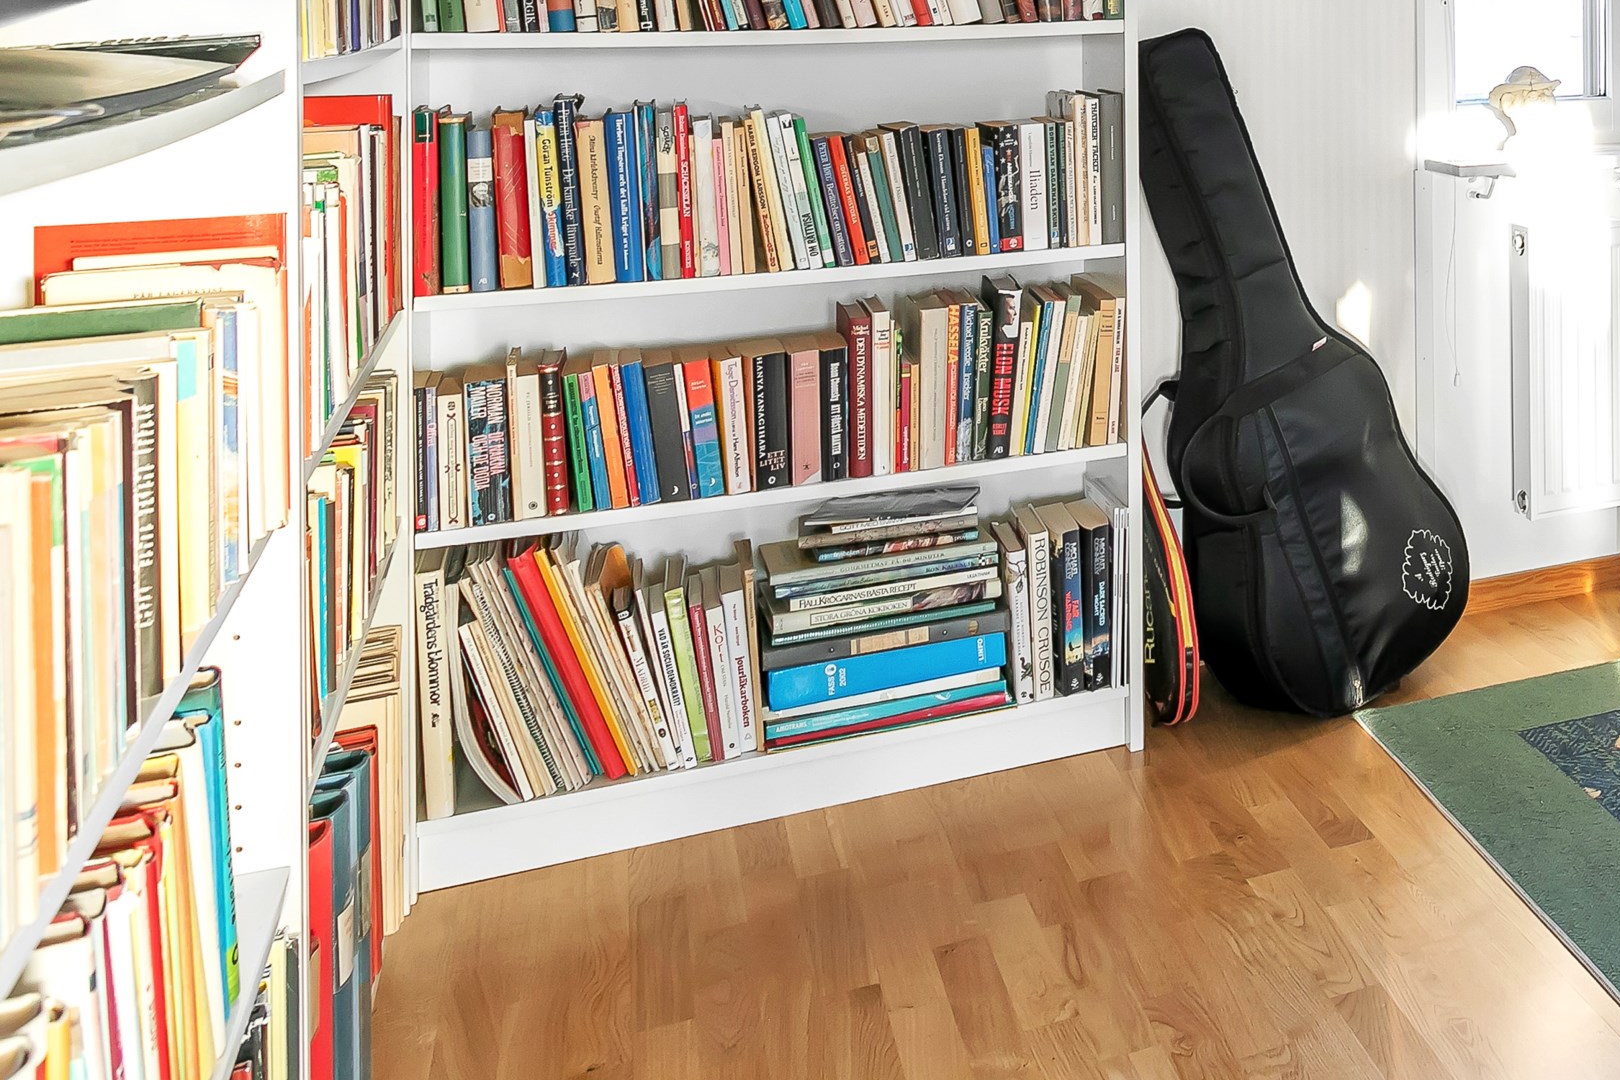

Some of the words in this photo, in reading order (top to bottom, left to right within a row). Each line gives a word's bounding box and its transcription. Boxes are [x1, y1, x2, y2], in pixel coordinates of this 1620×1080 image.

[558, 109, 571, 136] PETER
[615, 119, 623, 145] Herbert
[747, 124, 756, 147] MARIA
[541, 138, 553, 165] Göran
[817, 141, 828, 163] PETER
[935, 132, 944, 153] Kerstin
[616, 146, 625, 173] Tingsten
[751, 148, 760, 177] BERGOM
[937, 154, 945, 174] Ekman
[543, 166, 556, 208] Tunström
[562, 167, 574, 182] De
[619, 186, 627, 198] det
[756, 178, 766, 209] LARSSON
[825, 183, 839, 220] Berättelser
[839, 164, 850, 195] IDÉERNAS
[846, 195, 857, 224] HISTORIA
[939, 175, 948, 203] Händelser
[1029, 169, 1041, 210] Iliaden
[563, 186, 578, 221] kanske
[620, 199, 628, 216] kalla
[619, 216, 629, 236] kriget
[802, 212, 817, 243] RÄTTVISA
[833, 220, 841, 232] om
[564, 222, 582, 267] lämpade
[809, 243, 819, 257] OM
[836, 232, 846, 253] natten
[947, 305, 958, 363] HASSELA
[964, 309, 974, 339] Michael
[856, 337, 865, 355] DEN
[964, 339, 973, 366] Tweedie
[979, 318, 993, 373] Krukväxter
[993, 343, 1014, 375] ELON
[726, 361, 737, 379] Tage
[830, 362, 840, 377] Noam
[857, 355, 866, 406] DYNAMISKA
[830, 377, 840, 402] Chomsky
[964, 372, 973, 400] Insekter
[991, 377, 1012, 416] MUSK
[471, 386, 487, 420] MAILER
[487, 384, 503, 424] NORMAN
[831, 404, 840, 414] ATT
[488, 431, 504, 443] DE
[758, 391, 766, 458] YANAGIHARA
[831, 415, 843, 433] FÖRSTÅ
[857, 407, 866, 460] MEDELTIDEN
[472, 434, 487, 452] OCH
[831, 433, 841, 455] MAKTEN
[474, 454, 488, 467] DE
[489, 444, 506, 475] NAKNA
[474, 468, 490, 492] DÖDA
[1034, 538, 1048, 621] ROBINSON
[419, 578, 441, 648] Trädgårdens
[814, 612, 841, 623] STORA
[841, 608, 867, 619] GRÖNA
[867, 601, 909, 616] KOKBOKEN
[1065, 591, 1073, 631] WARNING
[1072, 600, 1080, 617] FAIR
[658, 628, 669, 641] VAD
[661, 641, 671, 649] ÄR
[1037, 627, 1050, 694] CRUSOE
[427, 649, 443, 706] blommor
[633, 657, 650, 693] MADRID
[661, 650, 681, 707] SOCIALDEMOKRATI?
[735, 656, 750, 727] jourläkarboken
